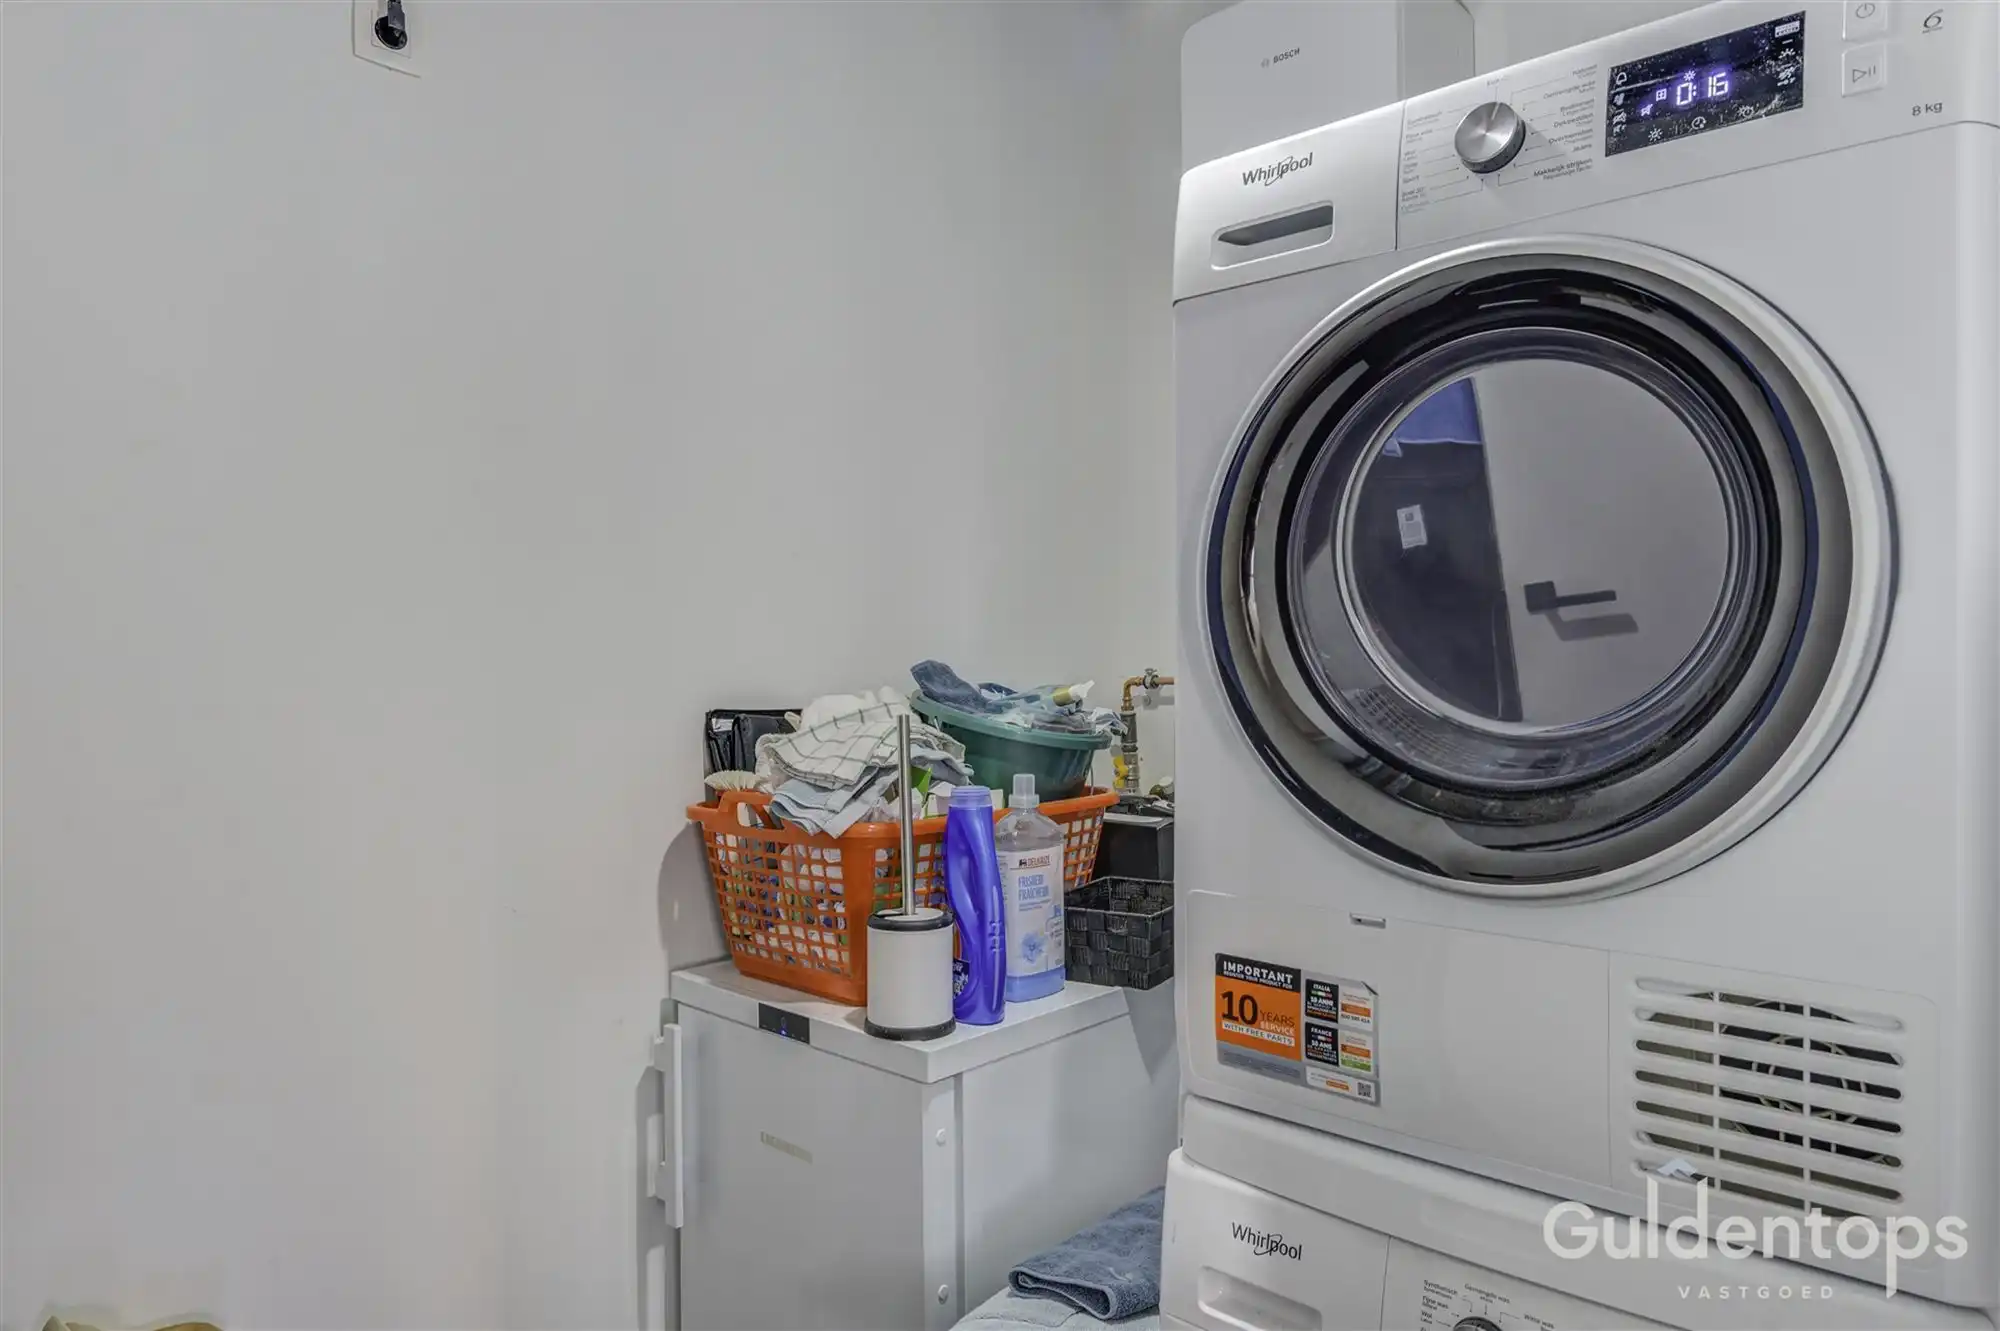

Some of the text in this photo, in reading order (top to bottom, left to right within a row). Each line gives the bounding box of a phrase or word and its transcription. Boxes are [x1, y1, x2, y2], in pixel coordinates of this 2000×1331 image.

[1273, 47, 1300, 64] BOSCH
[1676, 71, 1729, 106] 0:16
[1911, 101, 1944, 117] 8 kg
[1242, 152, 1313, 186] Whirlpool
[1223, 961, 1294, 984] IMPORTANT
[1259, 977, 1282, 988] PRODUCT
[1221, 990, 1258, 1026] 10
[1260, 1010, 1296, 1028] YEARS
[1260, 1020, 1295, 1037] SERVICE
[1224, 1022, 1293, 1045] WITH FREE PARTS
[1310, 1027, 1333, 1037] FRANCE
[1231, 1221, 1302, 1261] Whirlpool
